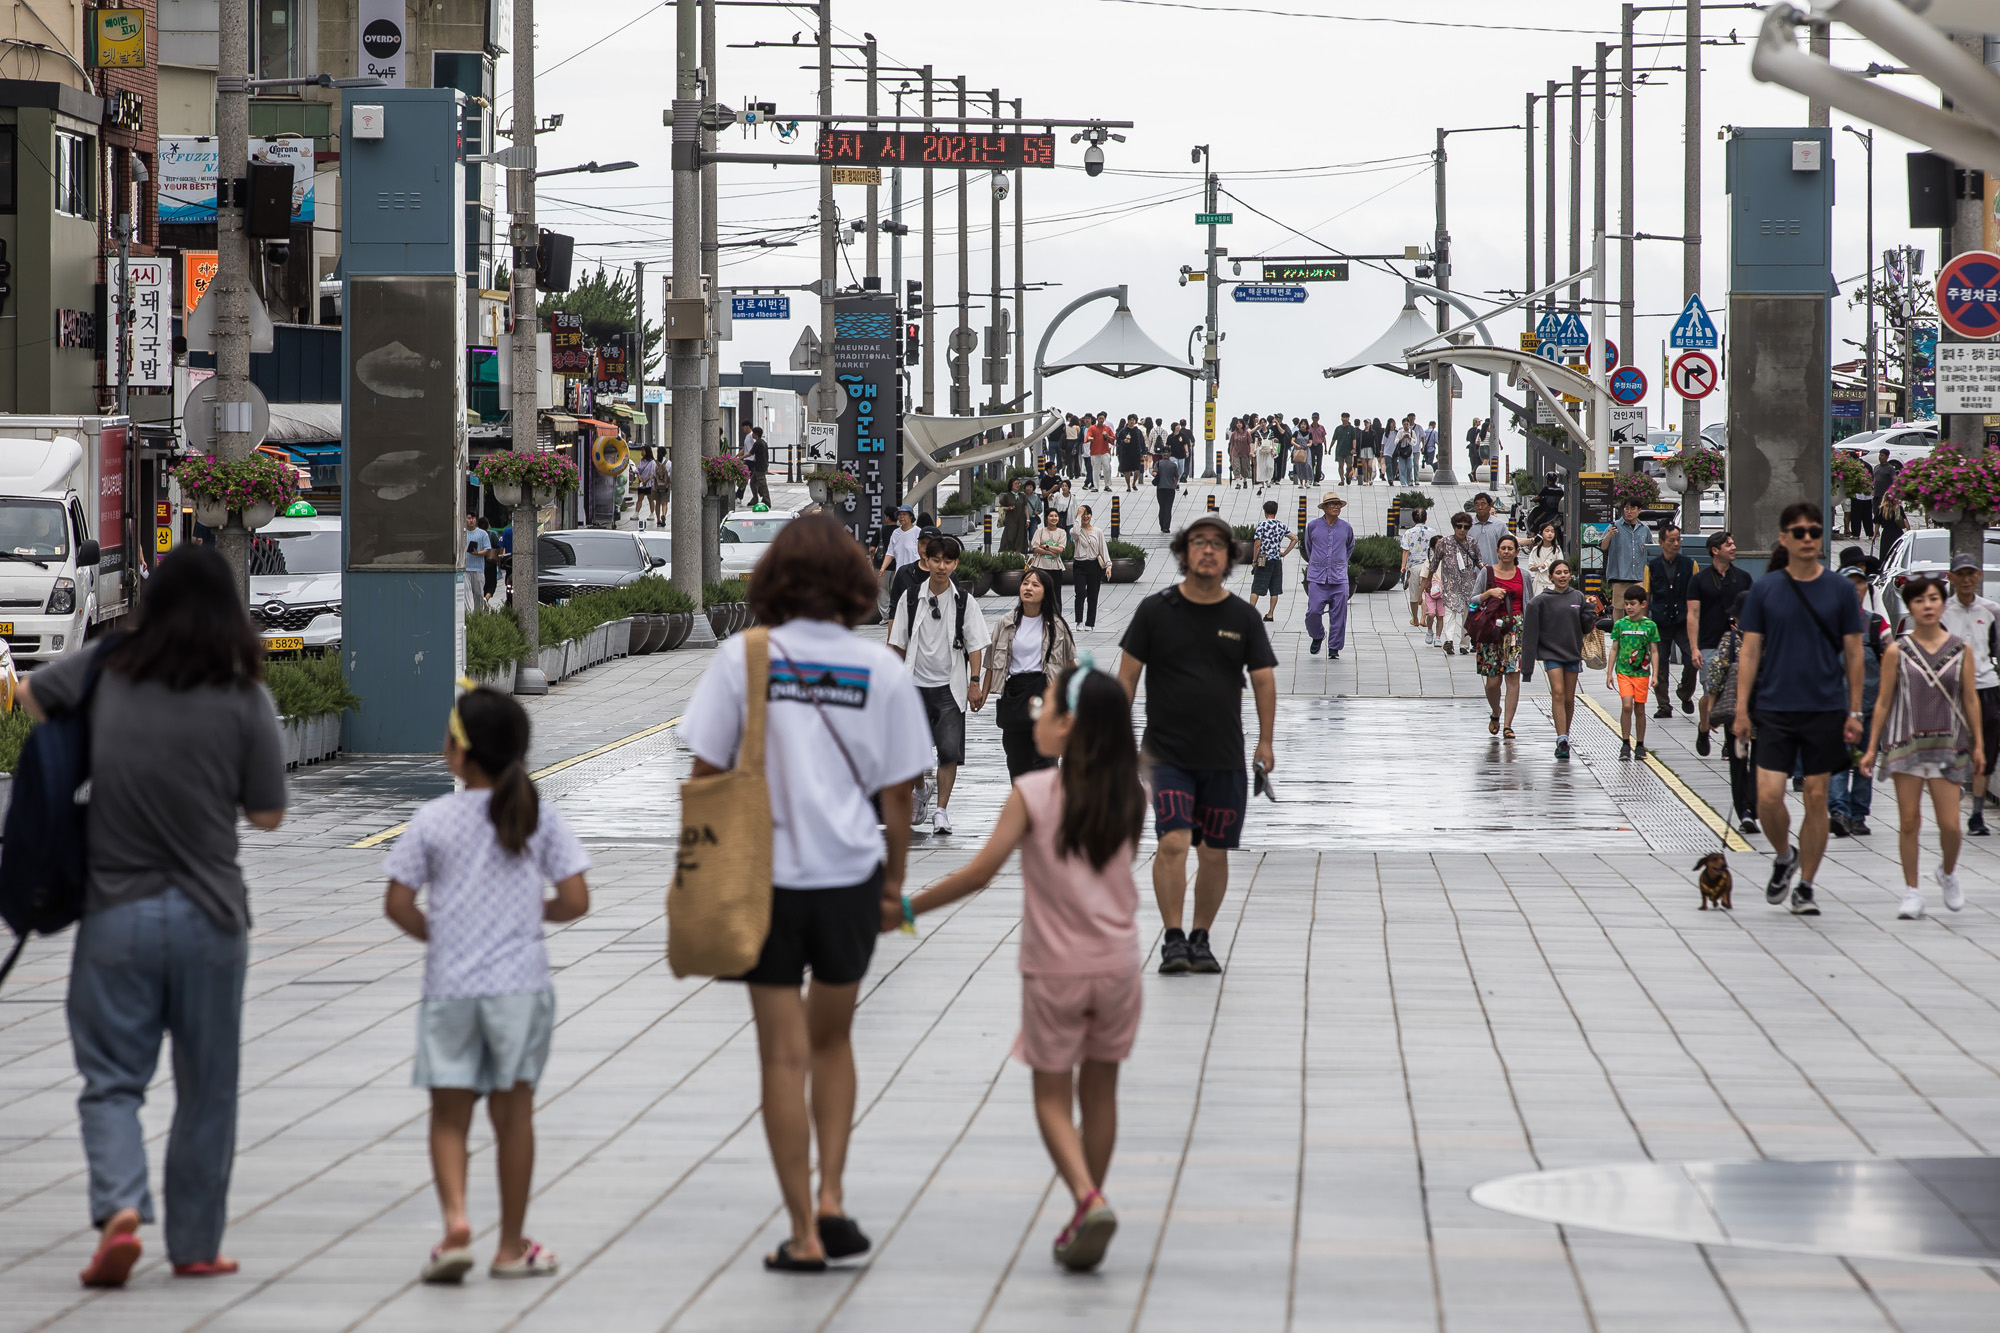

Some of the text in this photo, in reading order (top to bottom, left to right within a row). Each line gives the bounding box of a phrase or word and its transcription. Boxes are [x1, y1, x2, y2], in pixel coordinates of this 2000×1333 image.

[364, 35, 401, 43] OVERDO
[269, 145, 298, 154] Corona
[923, 135, 1005, 163] 2021년
[176, 153, 219, 162] FUZZY
[130, 266, 154, 284] 4시
[1248, 288, 1292, 297] 해운대해변로
[557, 314, 580, 328] 정통
[140, 290, 161, 380] 돼지국밥
[555, 333, 582, 346] 王家
[1676, 338, 1714, 346] 횡단보도
[601, 346, 620, 358] 정통
[606, 362, 625, 373] 王家
[598, 378, 628, 392] 탕후루
[1614, 382, 1642, 390] 주정차금지
[839, 374, 885, 452] 해운대
[157, 504, 167, 517] 로
[158, 531, 169, 545] 상
[275, 639, 300, 649] 5829
[769, 681, 864, 704] pataonia
